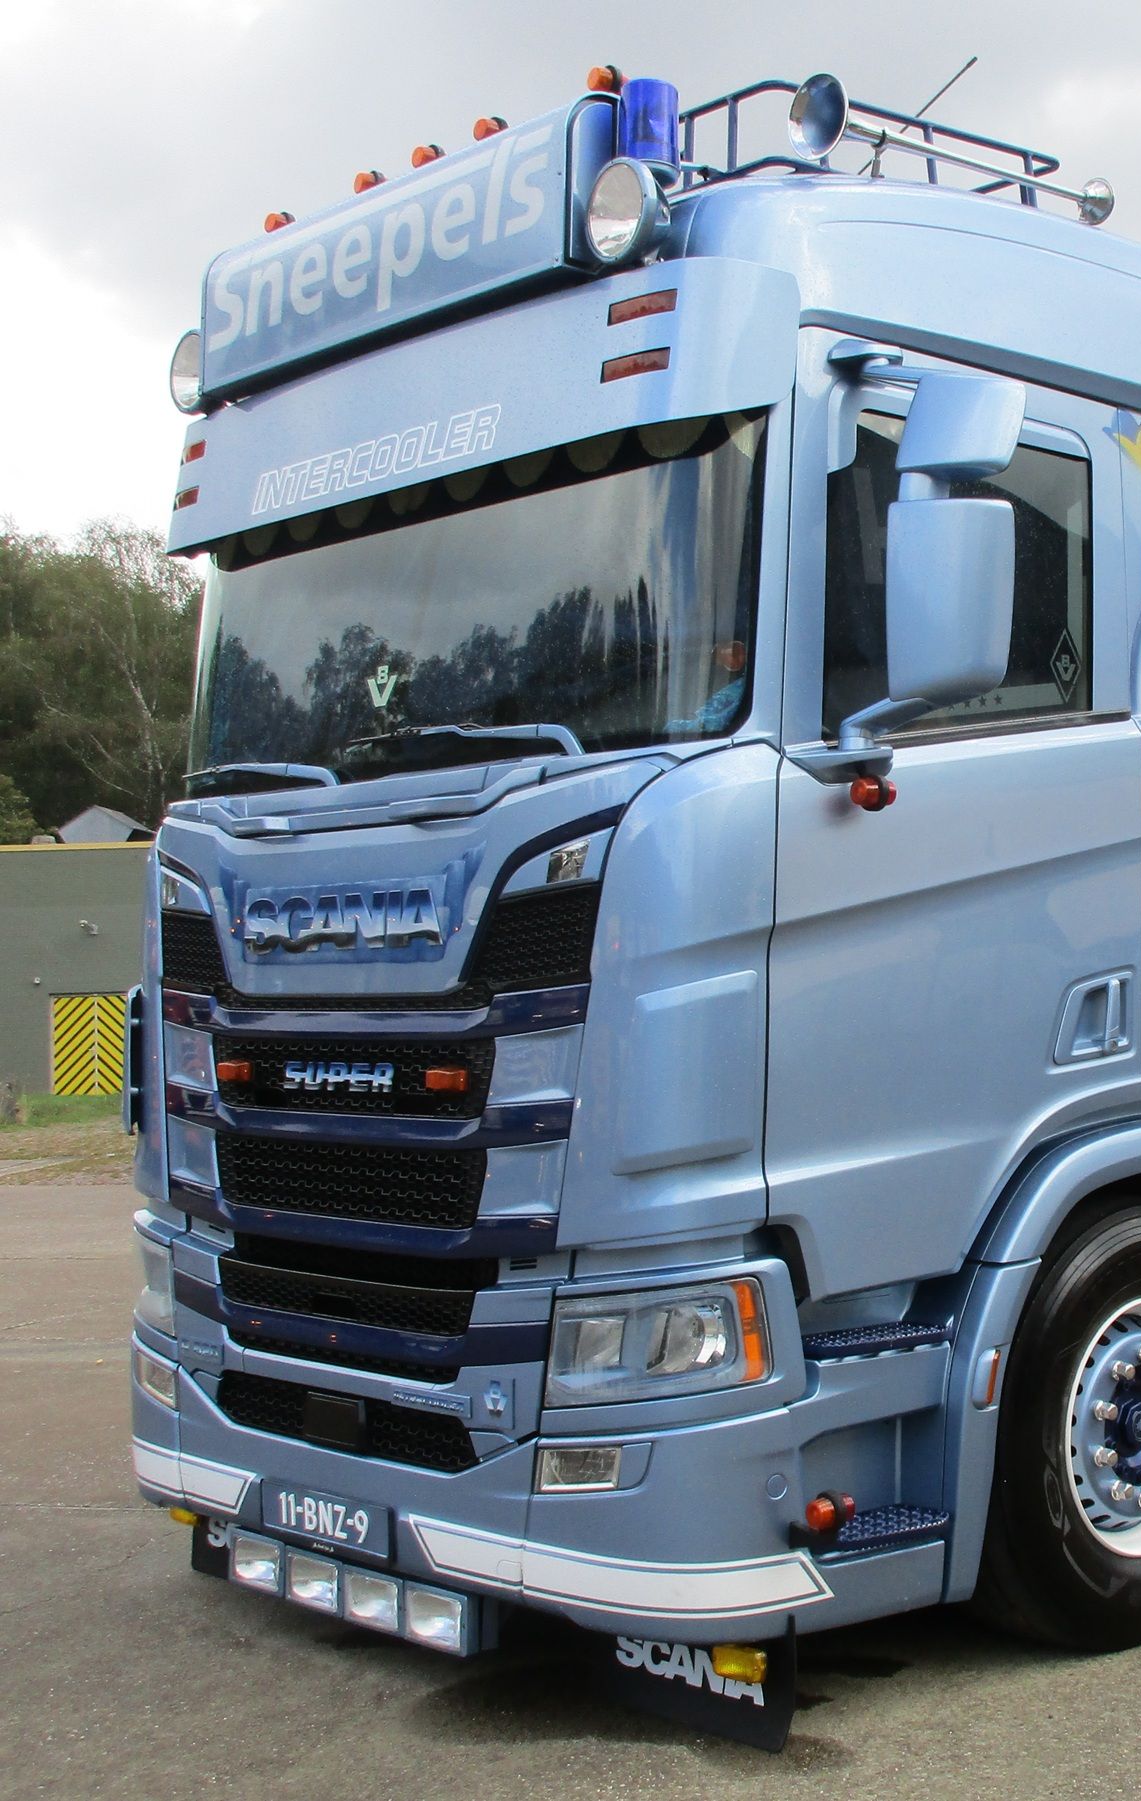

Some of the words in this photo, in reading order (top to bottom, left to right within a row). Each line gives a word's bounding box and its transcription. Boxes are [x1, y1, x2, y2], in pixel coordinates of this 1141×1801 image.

[208, 125, 553, 353] Sneepels
[252, 404, 501, 516] INTERCOOLER
[244, 888, 443, 955] SCANIA
[283, 1061, 395, 1092] SUPER
[279, 1491, 369, 1544] 11-BNZ-9
